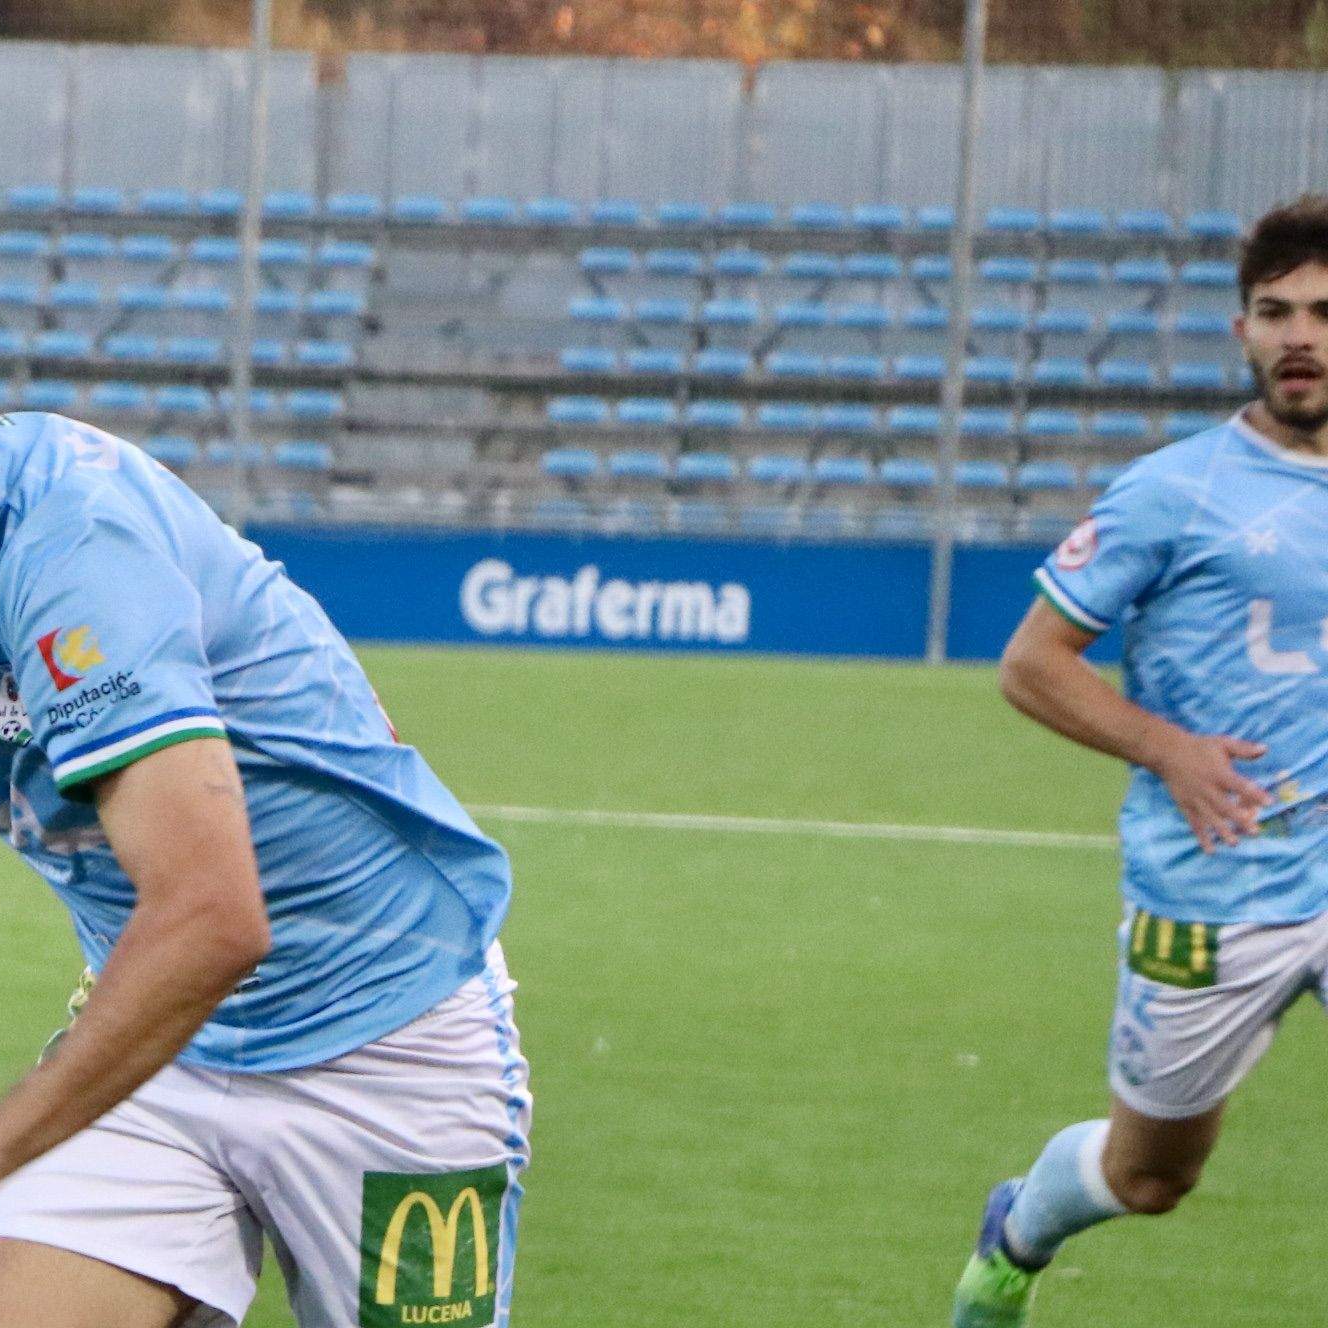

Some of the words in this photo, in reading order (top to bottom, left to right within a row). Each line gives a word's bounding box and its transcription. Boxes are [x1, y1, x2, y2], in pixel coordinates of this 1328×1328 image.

[459, 558, 751, 643] Graferma
[47, 671, 134, 725] Diputació
[401, 1301, 472, 1323] LUCENA
